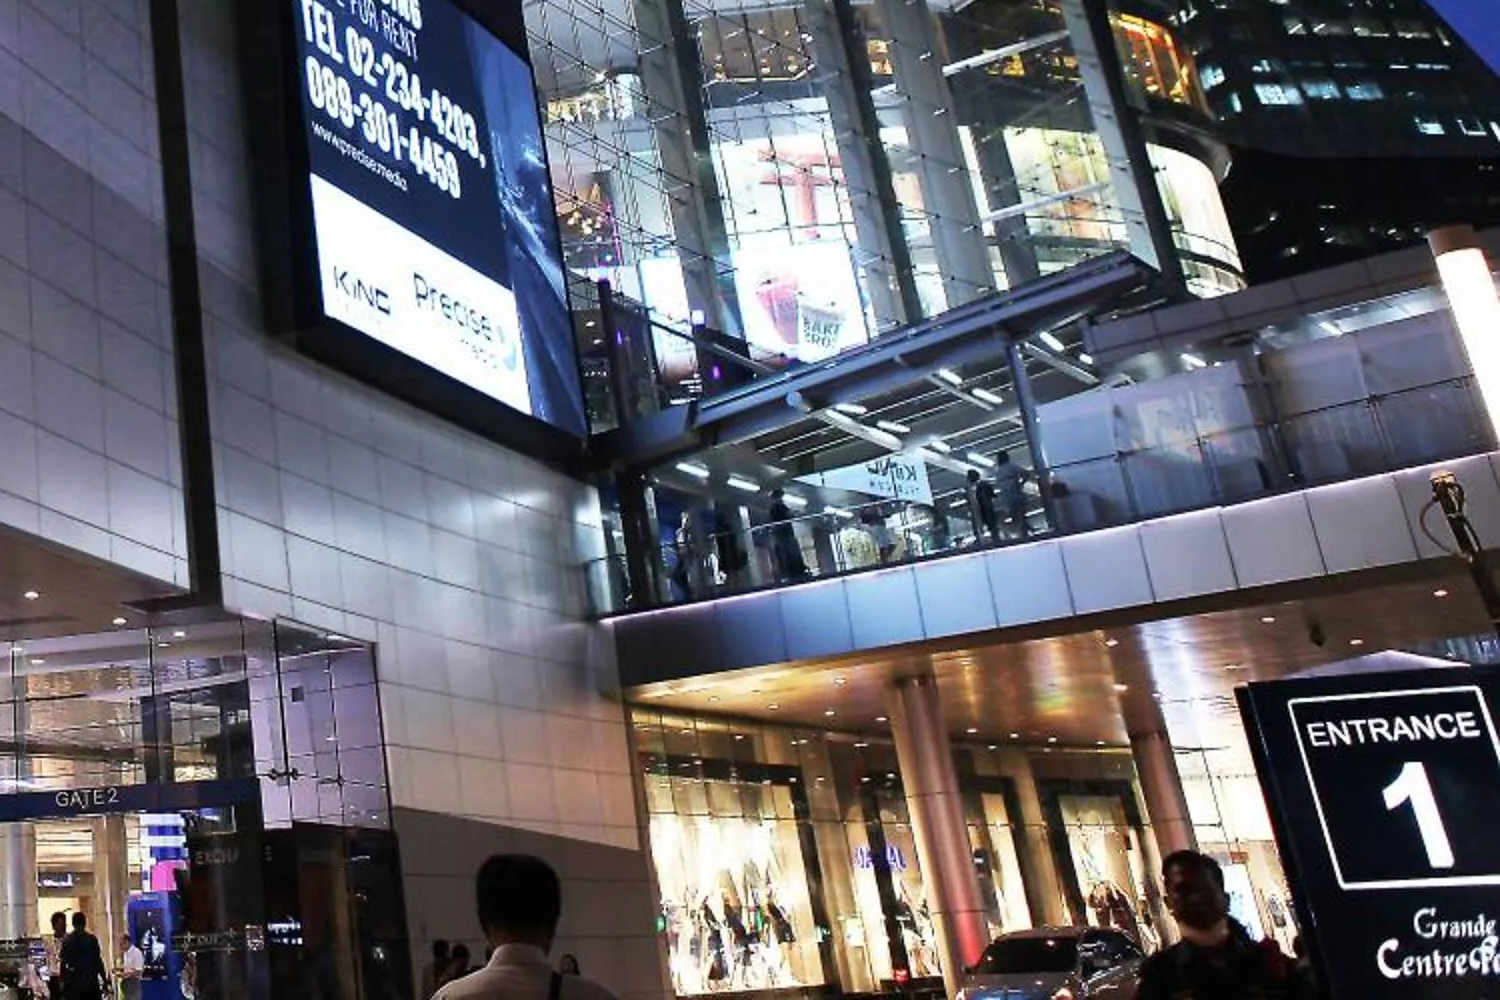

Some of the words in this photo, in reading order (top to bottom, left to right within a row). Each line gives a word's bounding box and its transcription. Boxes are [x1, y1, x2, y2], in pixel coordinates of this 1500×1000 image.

[381, 9, 418, 62] RENT
[1306, 711, 1481, 747] ENTRANCE
[55, 789, 104, 808] GATE
[107, 787, 119, 803] 2
[1381, 761, 1456, 869] 1
[1413, 907, 1496, 938] Grande
